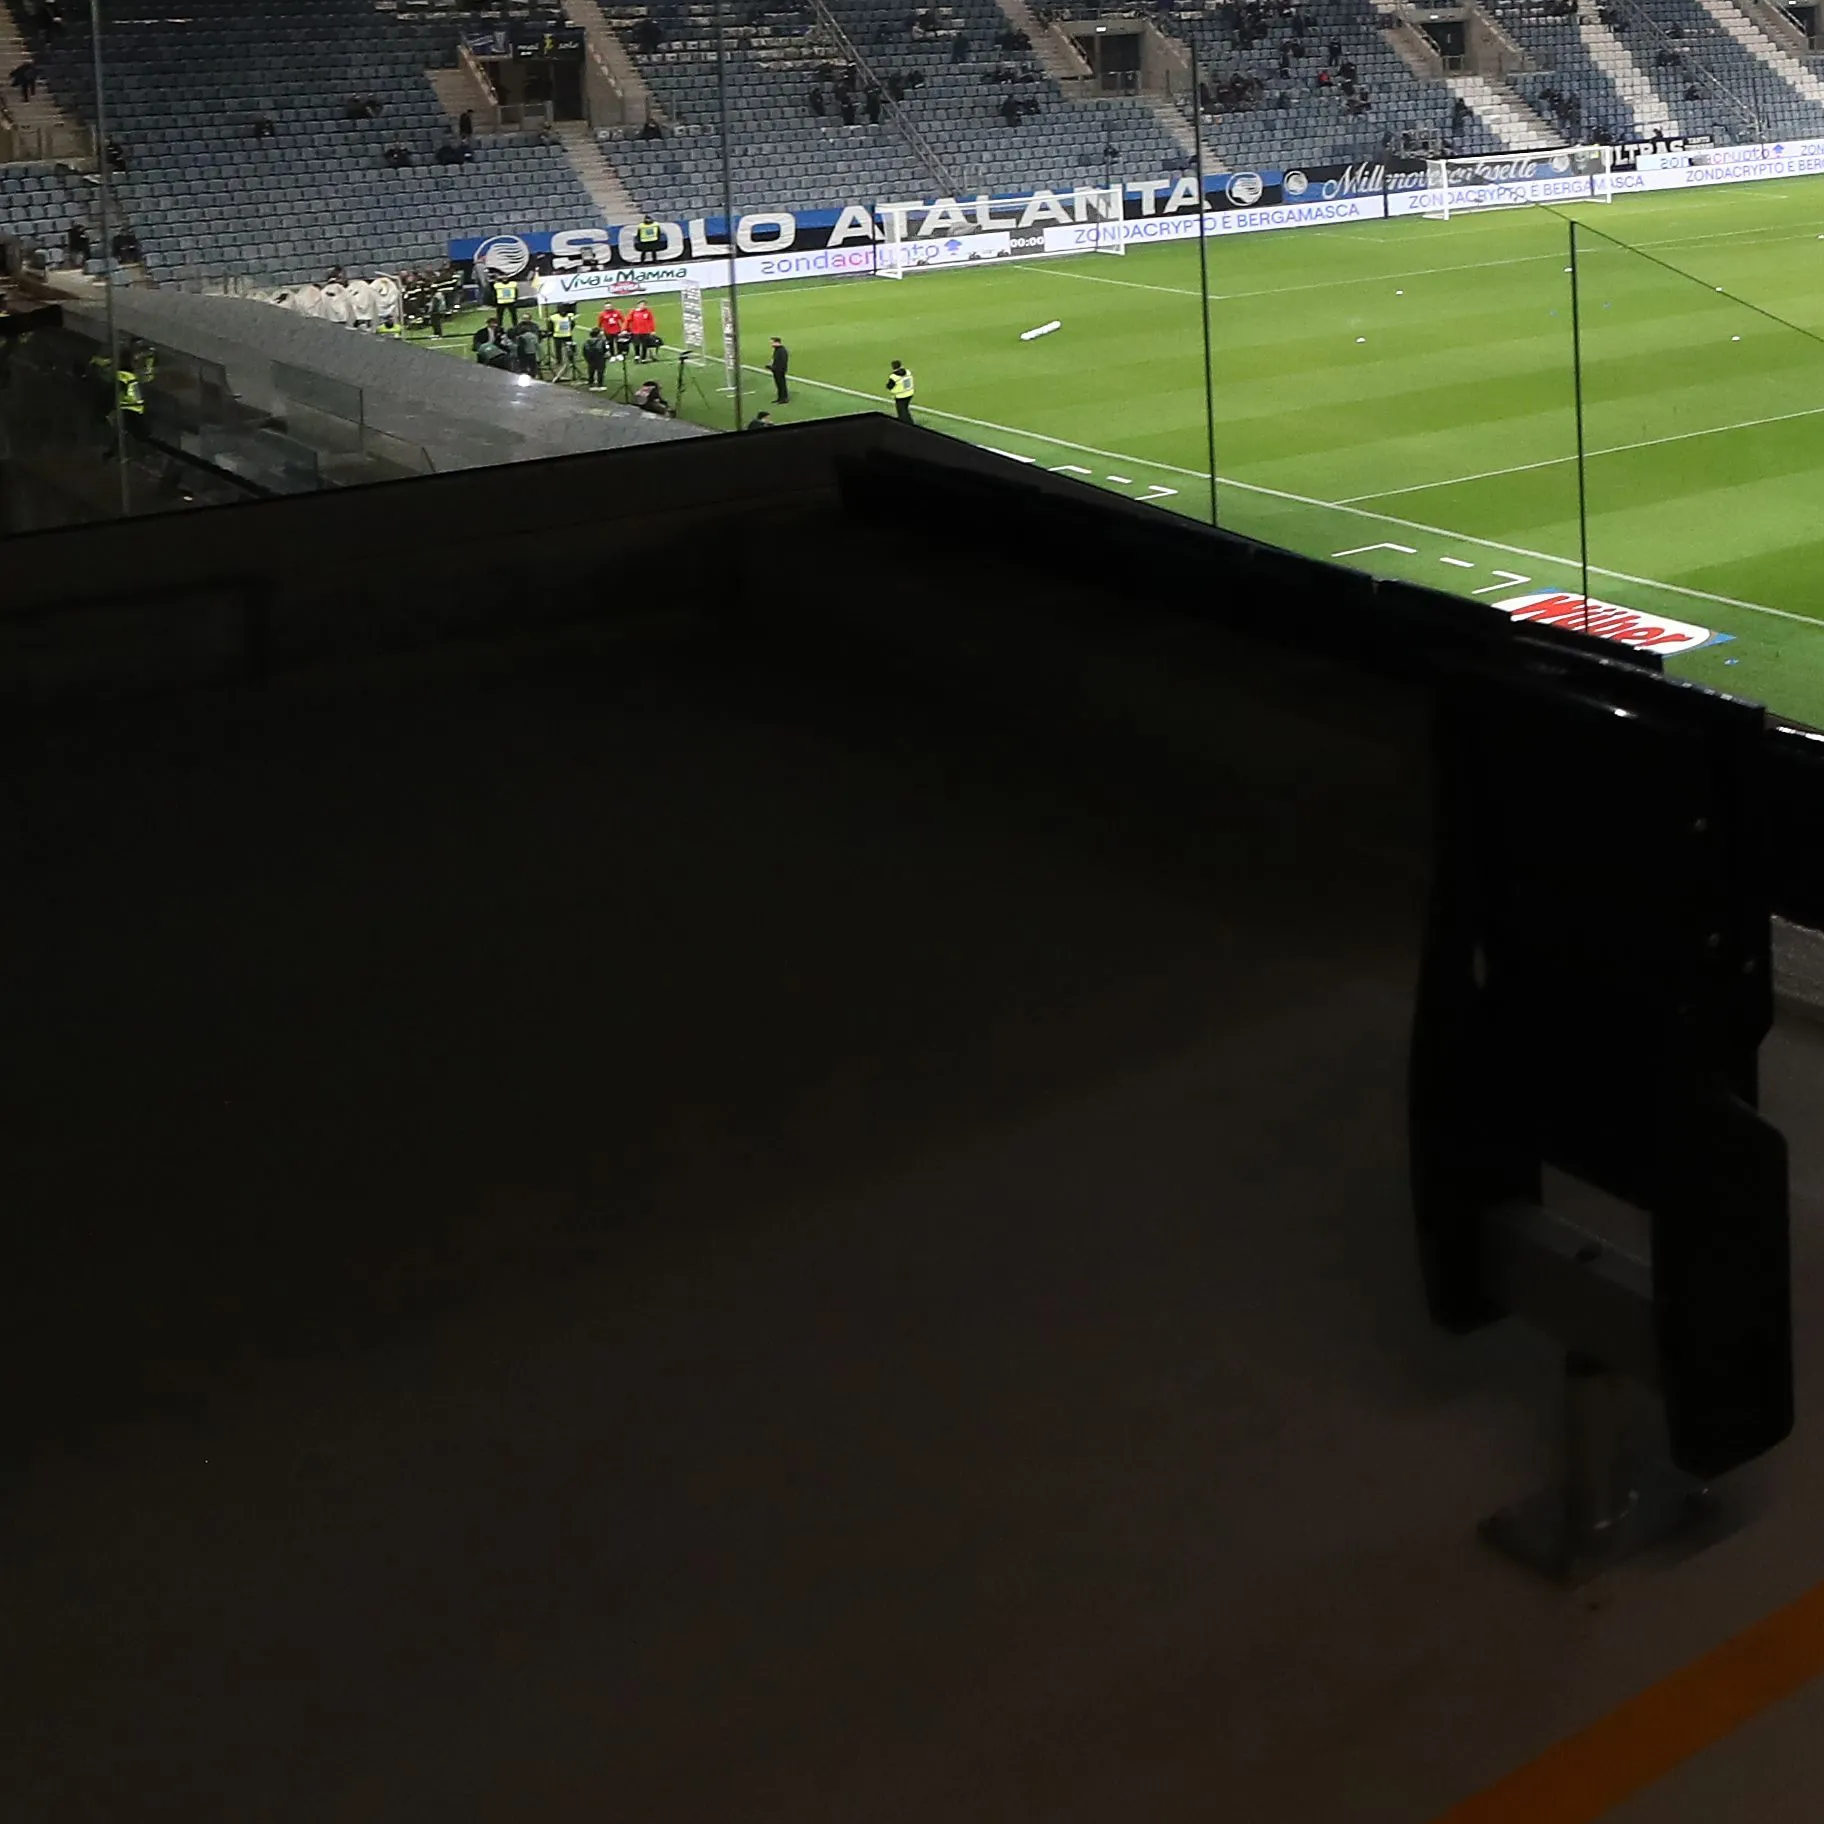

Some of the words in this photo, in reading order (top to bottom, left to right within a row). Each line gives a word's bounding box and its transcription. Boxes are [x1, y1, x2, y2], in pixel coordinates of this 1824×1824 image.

[551, 212, 796, 269] SOLO
[827, 177, 1213, 246] ATALANTA
[616, 267, 688, 283] Mamma
